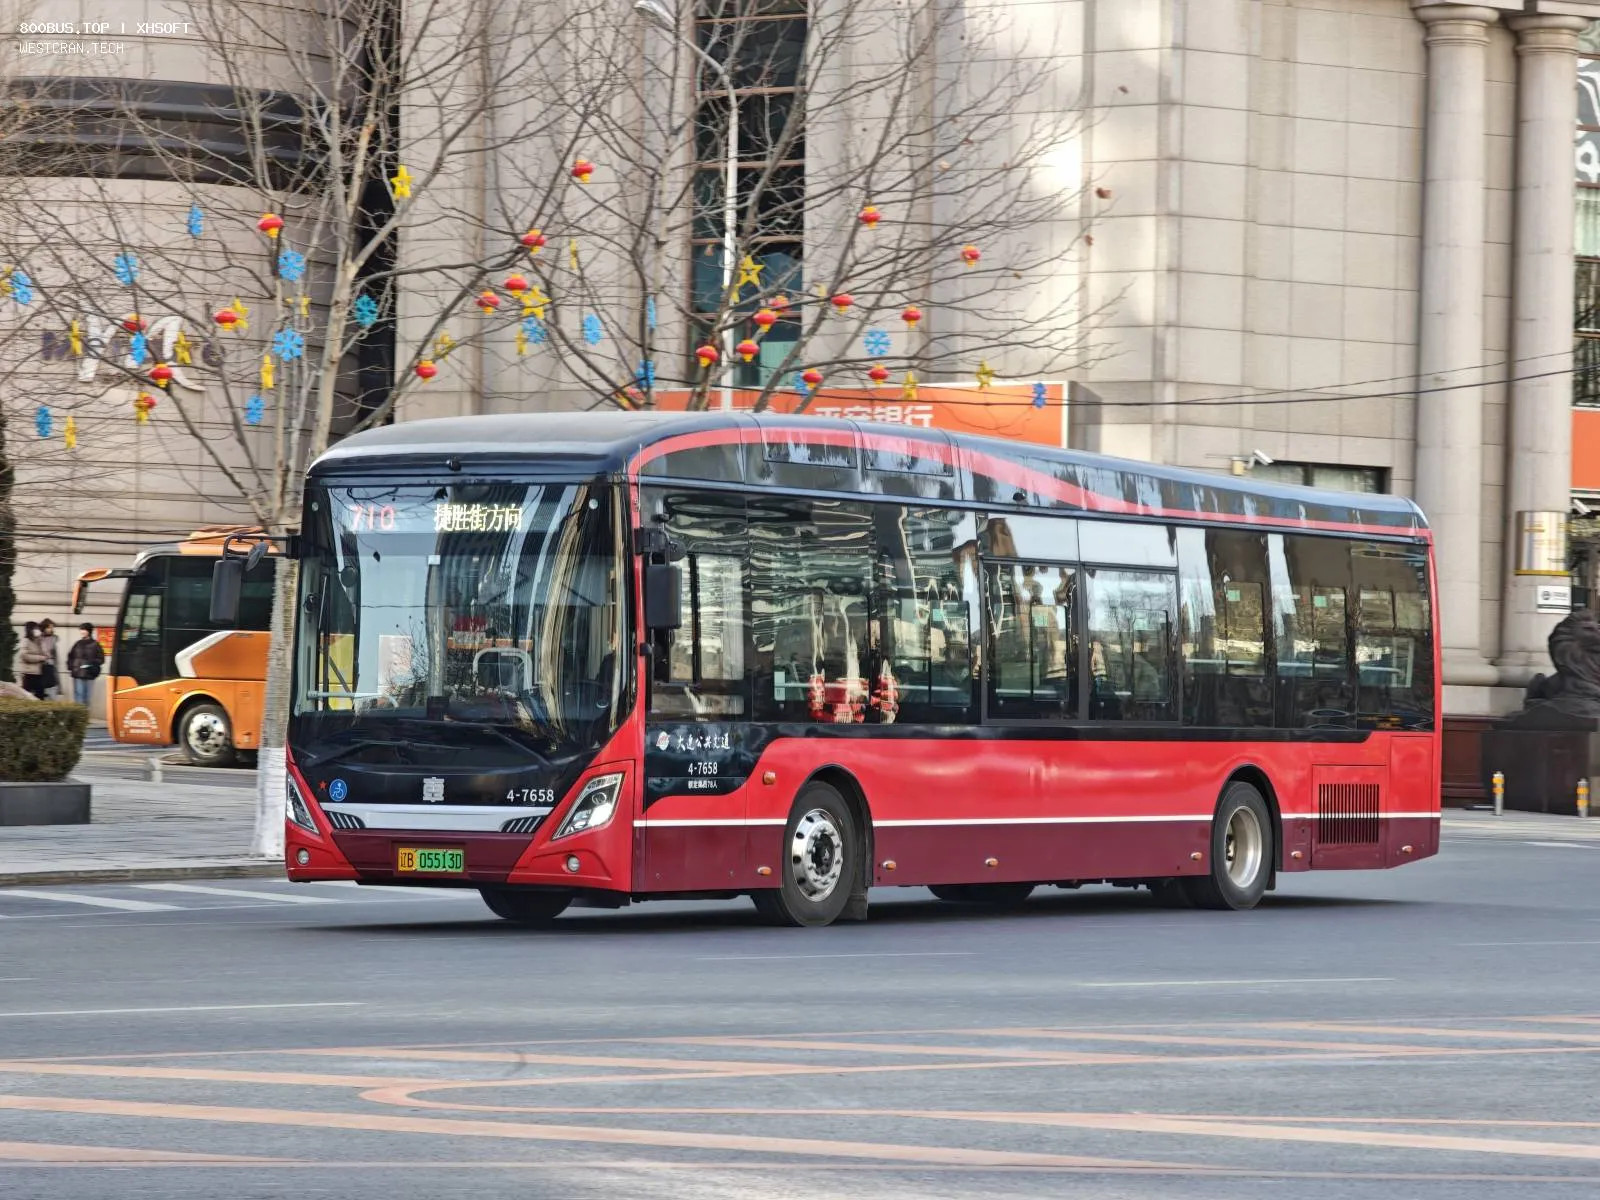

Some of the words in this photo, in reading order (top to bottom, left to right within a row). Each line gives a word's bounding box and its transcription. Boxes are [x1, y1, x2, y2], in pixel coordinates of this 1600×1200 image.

[350, 504, 396, 531] 710
[434, 504, 522, 532] 捷胜街方向
[687, 761, 718, 775] 4-7658
[506, 788, 555, 802] 4-7658
[419, 852, 462, 869] 05513D
